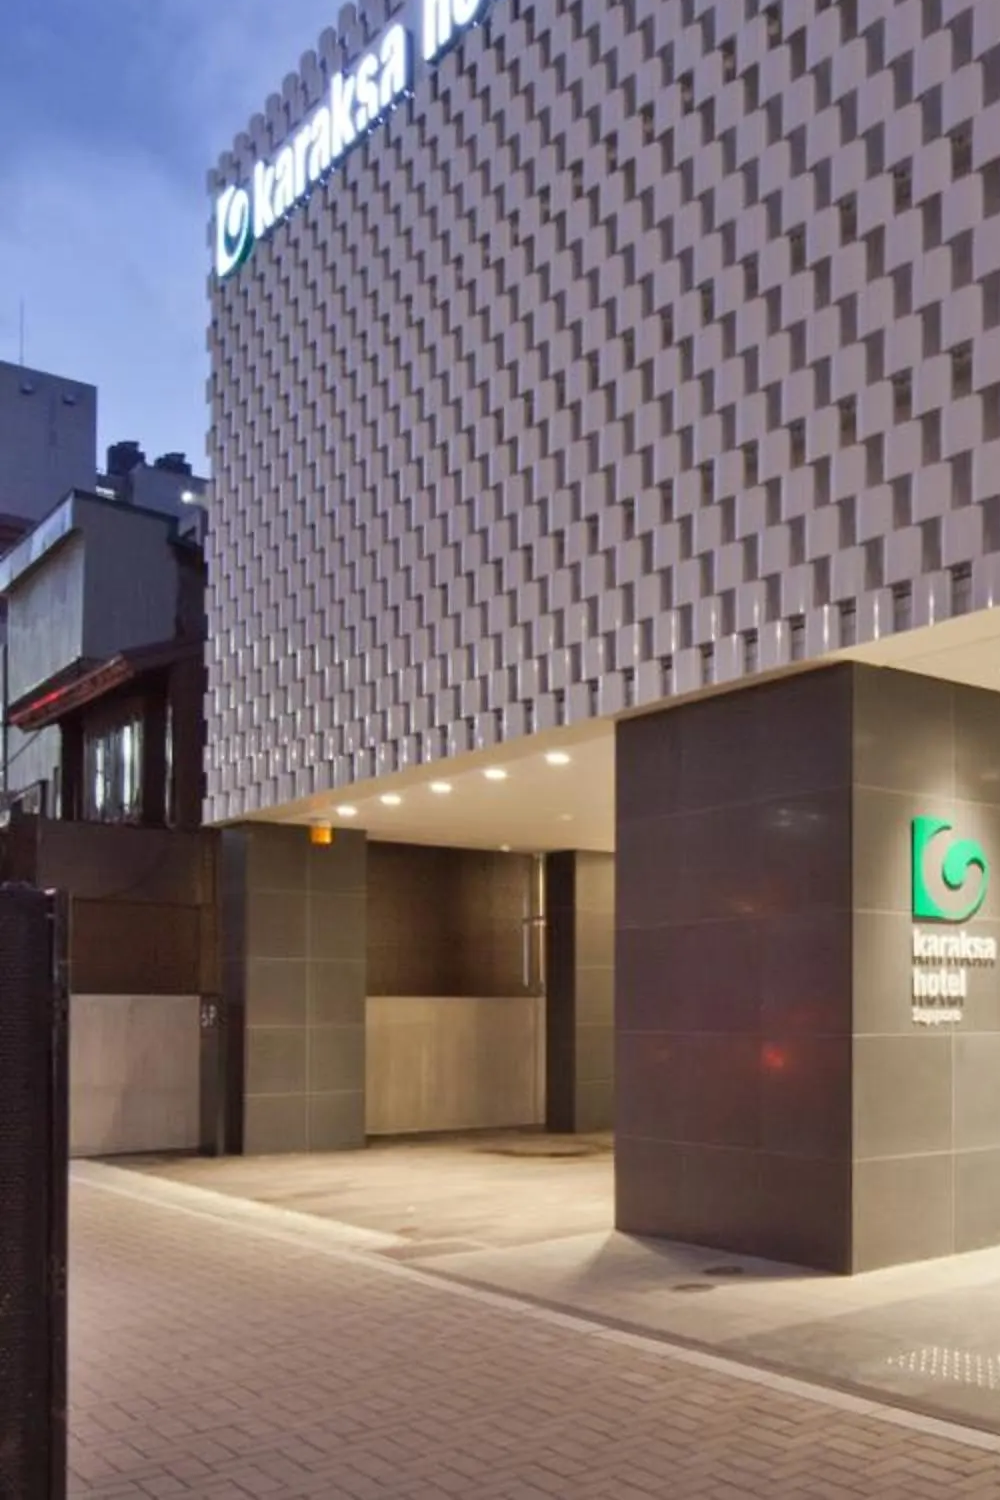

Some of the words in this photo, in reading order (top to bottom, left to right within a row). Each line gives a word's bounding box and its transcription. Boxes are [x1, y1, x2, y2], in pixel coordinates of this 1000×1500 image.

[253, 23, 407, 240] karaksa
[913, 927, 997, 960] karaksa
[913, 967, 968, 998] hotel
